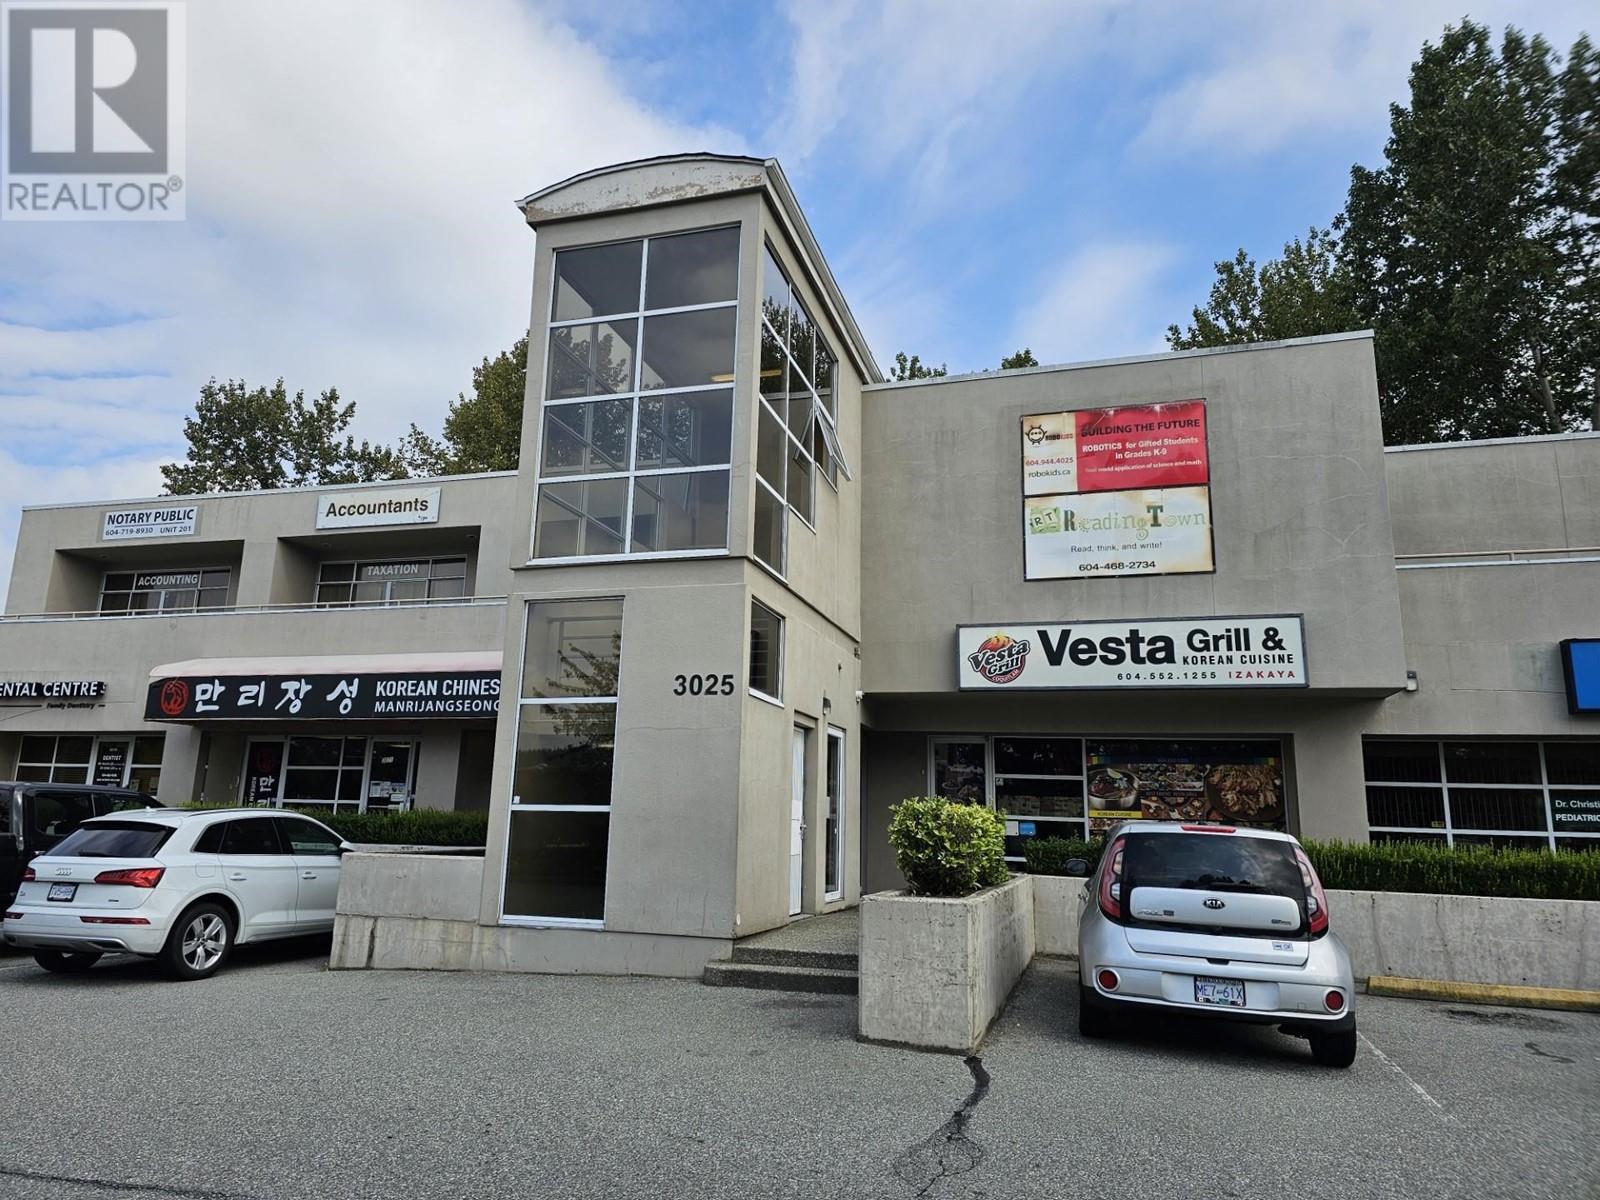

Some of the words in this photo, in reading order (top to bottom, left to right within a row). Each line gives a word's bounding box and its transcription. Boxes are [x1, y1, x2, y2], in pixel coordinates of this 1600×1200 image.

[1081, 425, 1132, 438] BUILDING
[1135, 422, 1155, 432] THE
[1158, 418, 1200, 430] FUTURE
[1082, 443, 1122, 453] ROBOTICS
[1138, 439, 1162, 449] Gifted
[1163, 436, 1199, 446] Students
[326, 497, 429, 518] Accountants
[107, 512, 152, 526] NOTARY
[154, 508, 195, 523] PUBLIC
[160, 526, 177, 534] UNIT
[1070, 544, 1094, 553] Read,
[1097, 543, 1119, 552] think,
[1121, 542, 1137, 550] and
[367, 564, 419, 577] TAXATION
[1078, 560, 1156, 572] 604-468-2734
[138, 574, 198, 587] ACCOUNTING
[1037, 628, 1176, 667] Vesta
[1186, 627, 1251, 653] Grill
[1261, 626, 1287, 651] &
[967, 639, 1031, 672] Vesta
[1182, 655, 1234, 666] KOREAN
[1240, 653, 1295, 664] CUISINE
[987, 655, 1021, 676] Grill
[1117, 671, 1218, 681] 604.552.1255
[1227, 670, 1296, 679] IZAKAYA
[43, 681, 98, 697] CENTRE
[375, 679, 438, 697] KOREAN
[673, 674, 735, 696] 3025
[1555, 800, 1569, 808] Dr.
